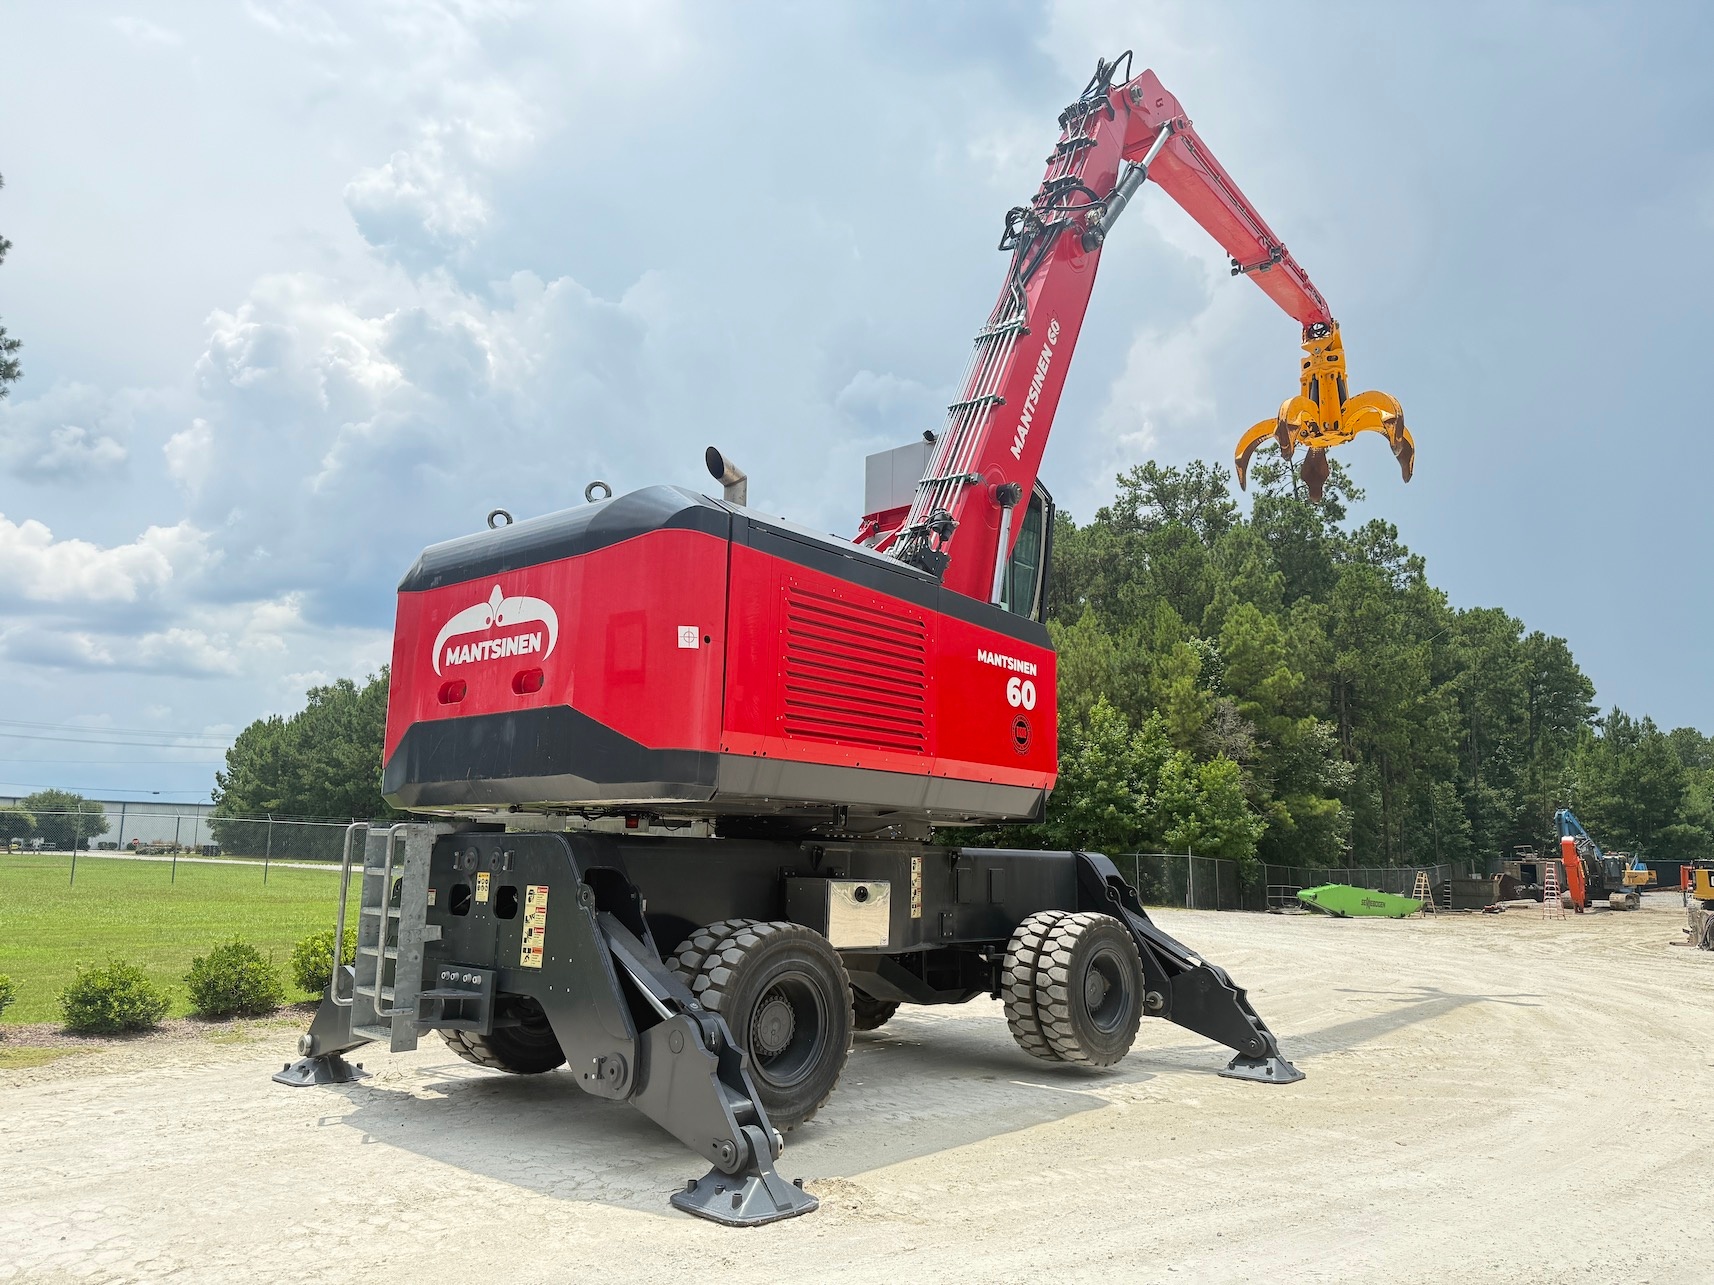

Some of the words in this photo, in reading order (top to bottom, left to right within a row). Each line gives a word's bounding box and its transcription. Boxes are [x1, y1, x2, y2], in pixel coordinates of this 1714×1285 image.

[1010, 342, 1053, 461] MANTSINEN
[445, 631, 542, 667] MANTSINEN
[977, 648, 1037, 677] MANTSINEN
[1006, 676, 1037, 711] 60
